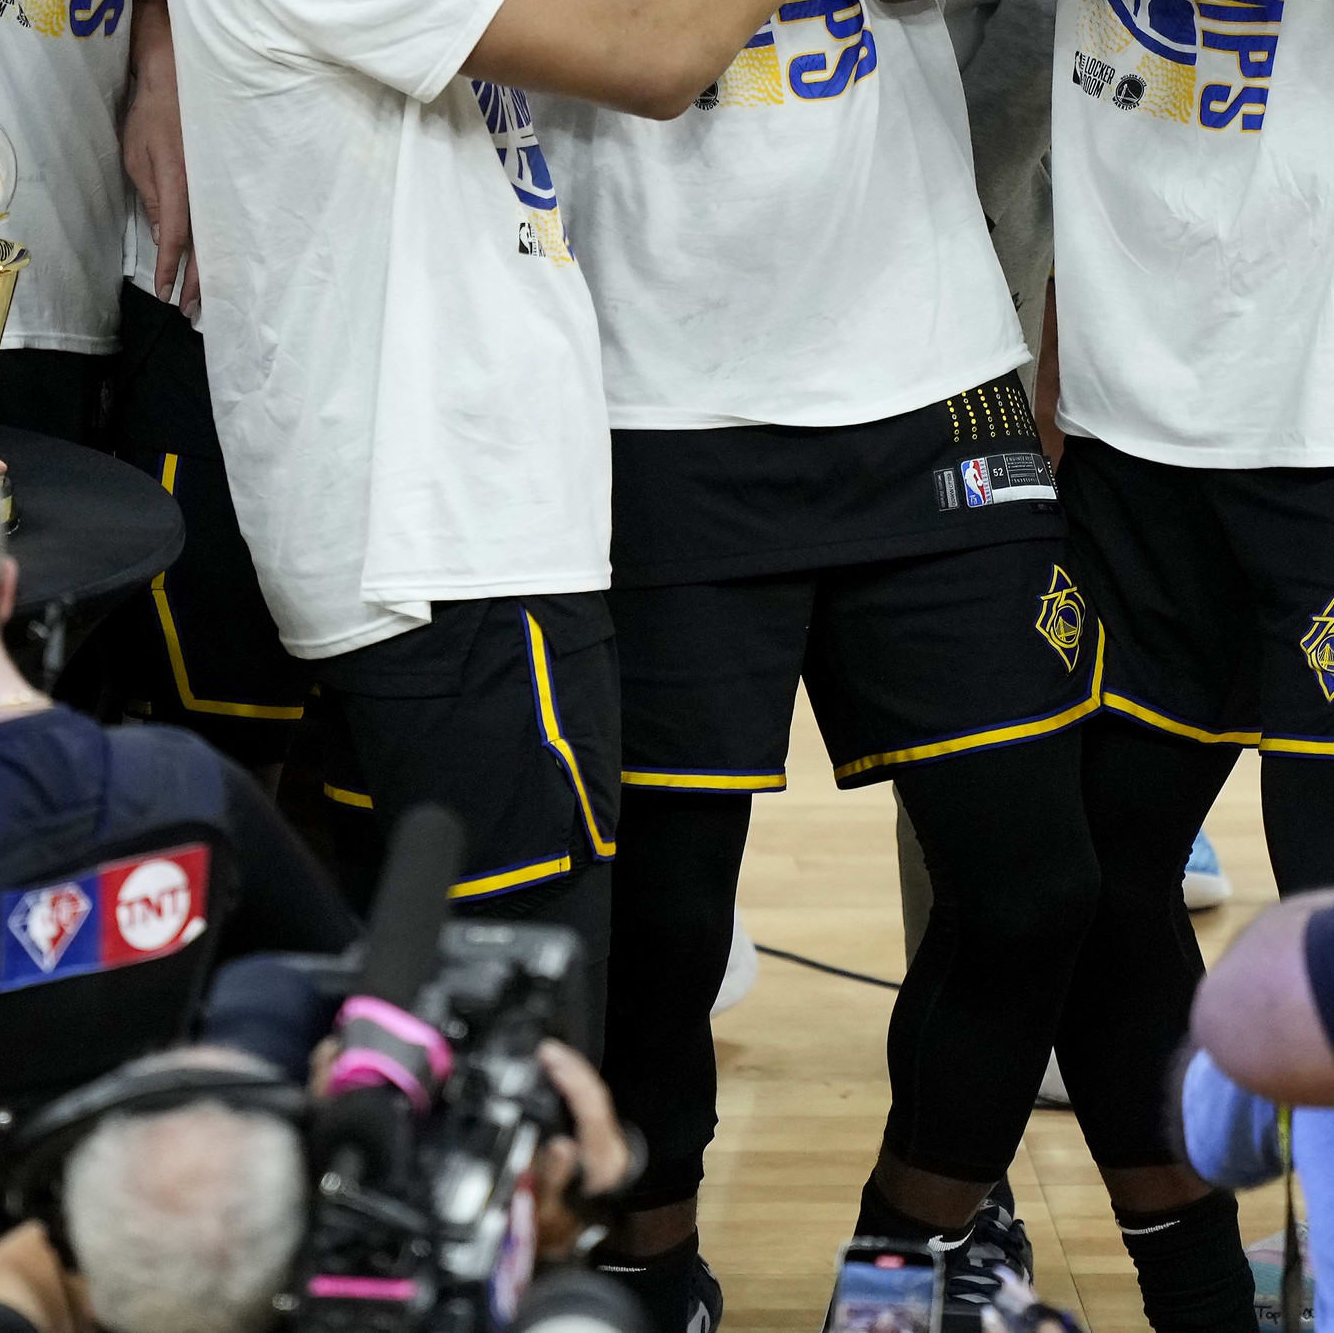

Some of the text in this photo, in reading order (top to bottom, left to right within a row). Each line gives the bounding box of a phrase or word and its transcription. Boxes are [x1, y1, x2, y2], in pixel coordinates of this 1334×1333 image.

[1084, 56, 1116, 85] LOCKER
[1082, 73, 1105, 99] ROOM
[993, 468, 1004, 477] 52
